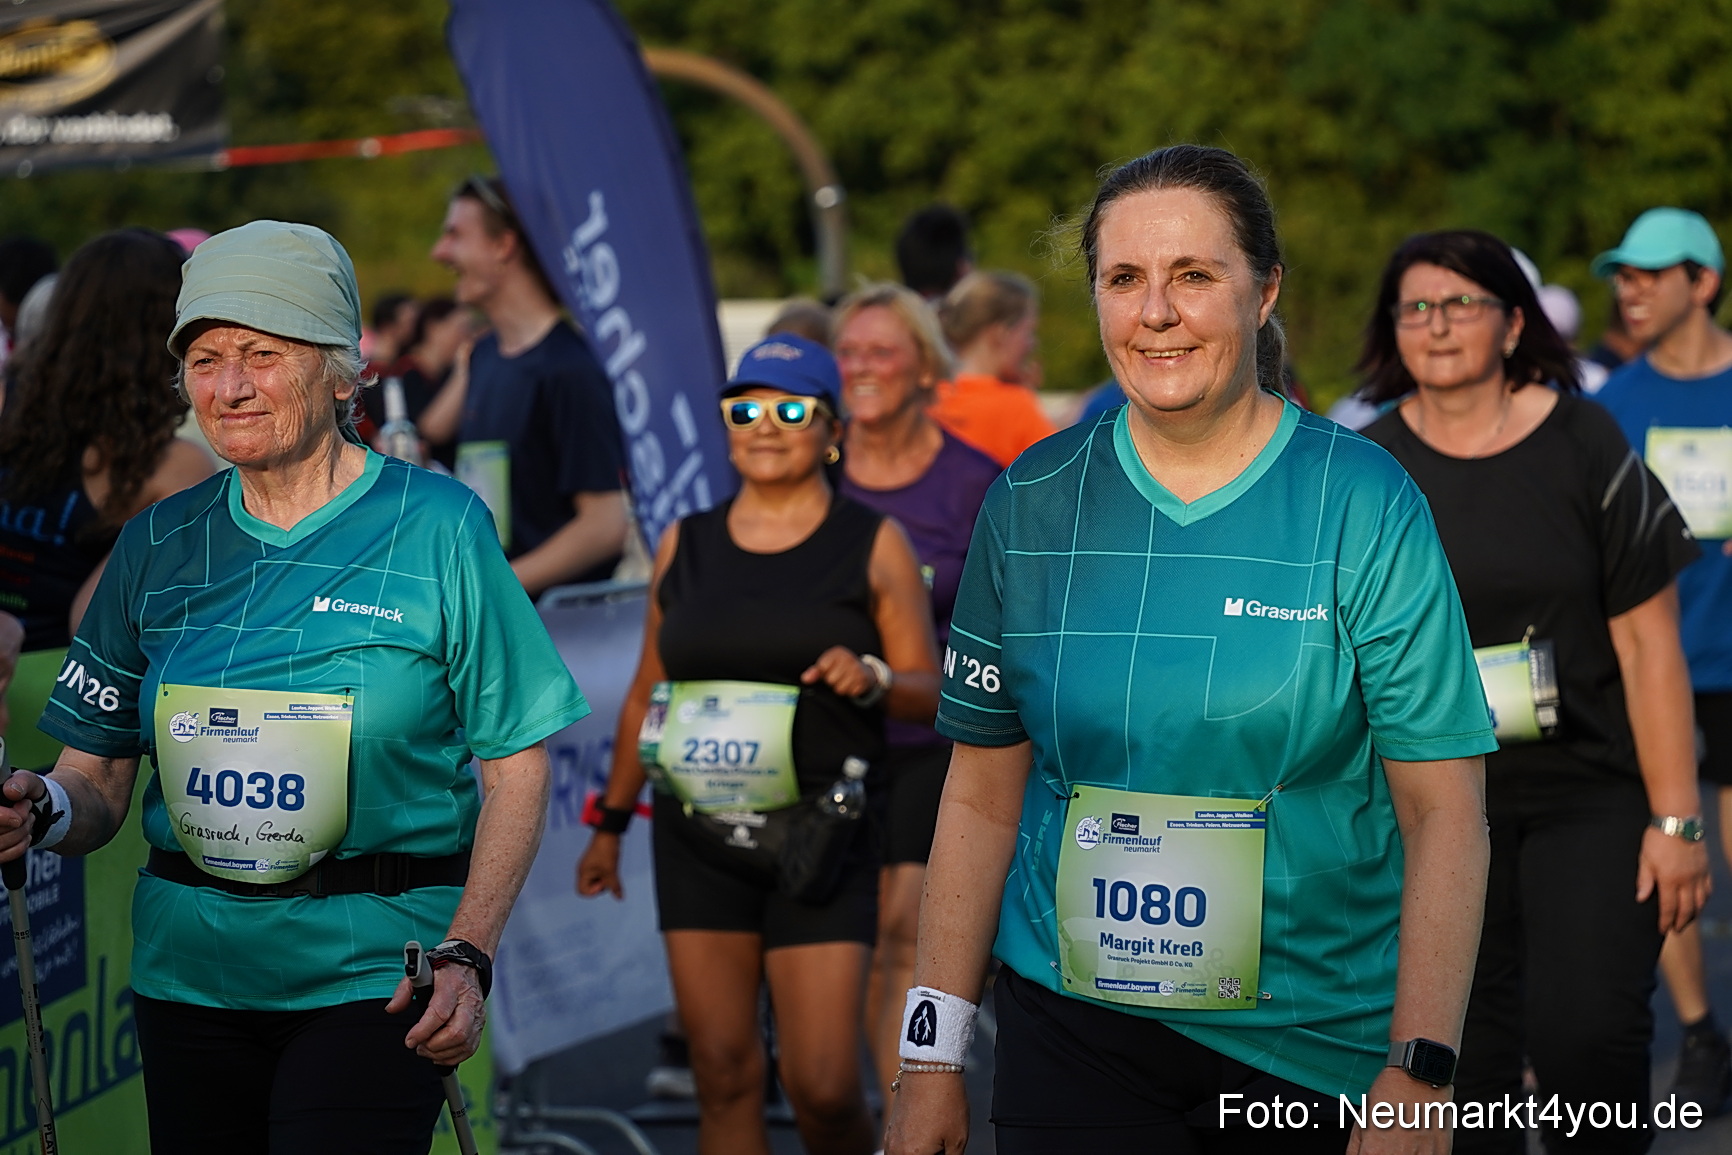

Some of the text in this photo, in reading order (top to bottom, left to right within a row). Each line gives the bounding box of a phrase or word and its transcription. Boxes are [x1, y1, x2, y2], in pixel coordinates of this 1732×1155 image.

[331, 598, 405, 624] Grasruck
[1245, 599, 1329, 622] Grasruck
[961, 654, 1001, 693] '26
[200, 726, 260, 737] Firmenlauf
[684, 738, 760, 765] 2307
[186, 767, 305, 812] 4038
[256, 821, 306, 844] Gerda
[1112, 818, 1138, 829] Fischer
[1102, 833, 1163, 846] Firmenlauf
[1123, 845, 1161, 853] neumarkt
[204, 857, 253, 870] firmenlauf.bayern
[1093, 877, 1207, 928] 1080
[1100, 932, 1204, 957] Margit Kreß
[1107, 954, 1130, 962] Grasruck
[1130, 957, 1151, 965] Projekt
[1097, 980, 1156, 993] firmenlauf.bayern
